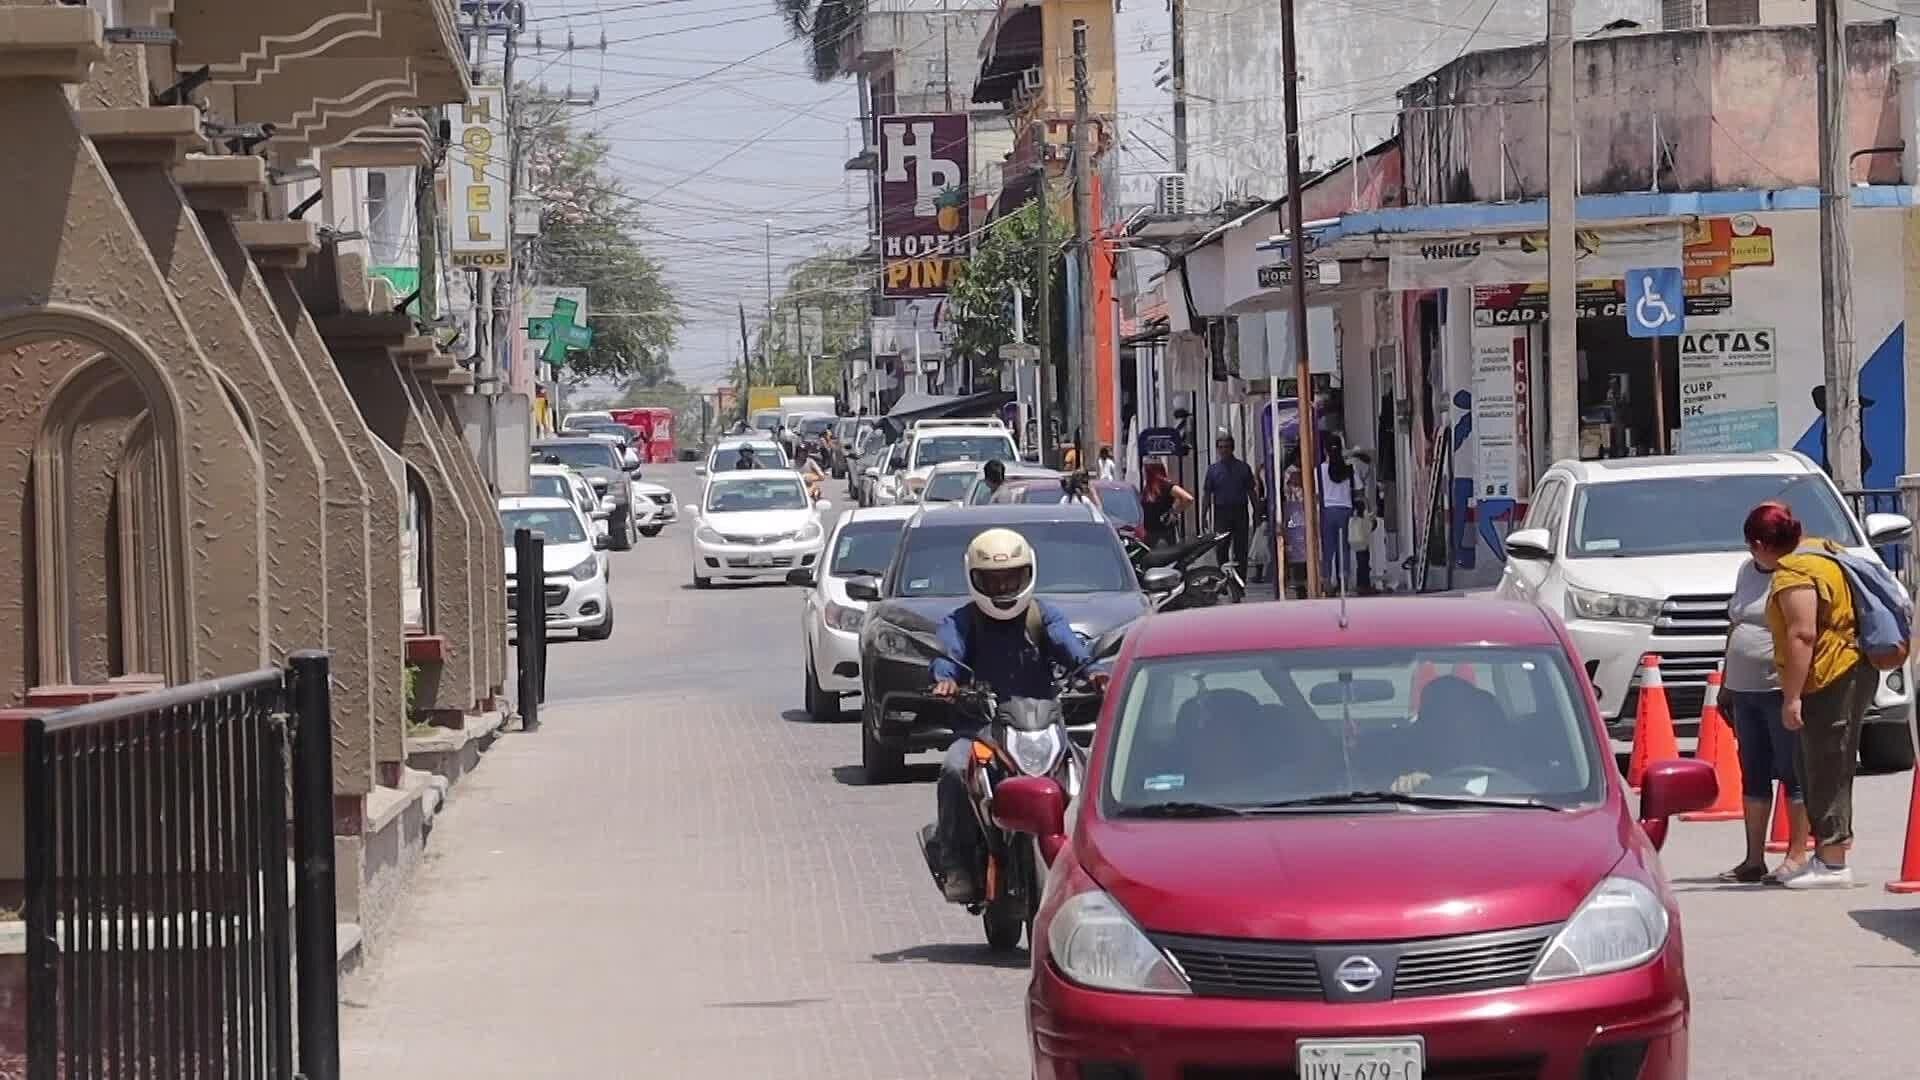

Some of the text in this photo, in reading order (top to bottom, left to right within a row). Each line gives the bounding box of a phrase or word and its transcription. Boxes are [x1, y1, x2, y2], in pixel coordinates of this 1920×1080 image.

[463, 96, 491, 241] HOTEL
[887, 235, 965, 256] HOTEL
[453, 254, 506, 265] MICOS
[1495, 309, 1535, 322] CAD
[1682, 331, 1770, 354] ACTAS
[1683, 381, 1713, 395] CURP
